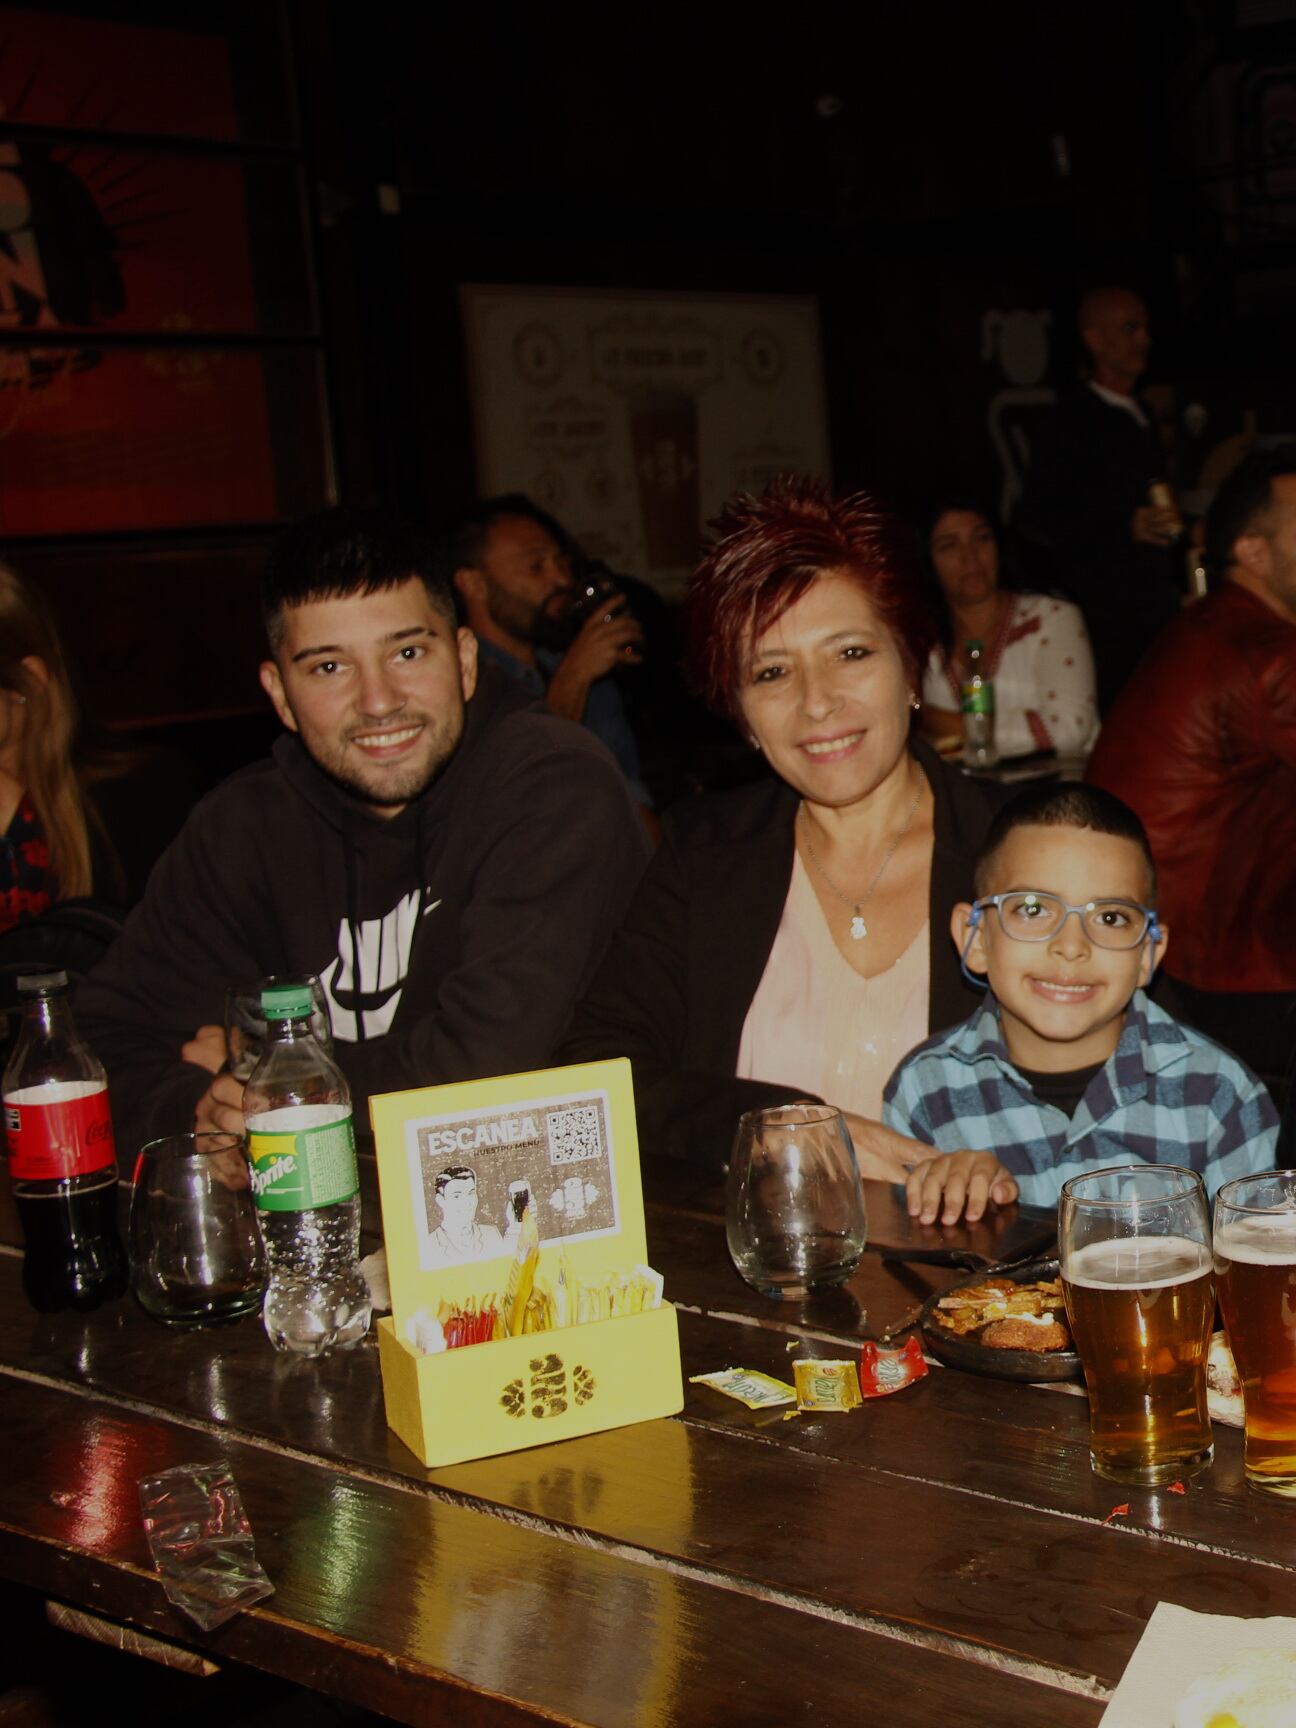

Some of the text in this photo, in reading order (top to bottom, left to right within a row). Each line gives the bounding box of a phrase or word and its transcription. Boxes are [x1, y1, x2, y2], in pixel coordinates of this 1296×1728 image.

[428, 1117, 539, 1156] ESCANEA
[473, 1144, 514, 1158] NUESTRO
[248, 1156, 295, 1196] Sprite
